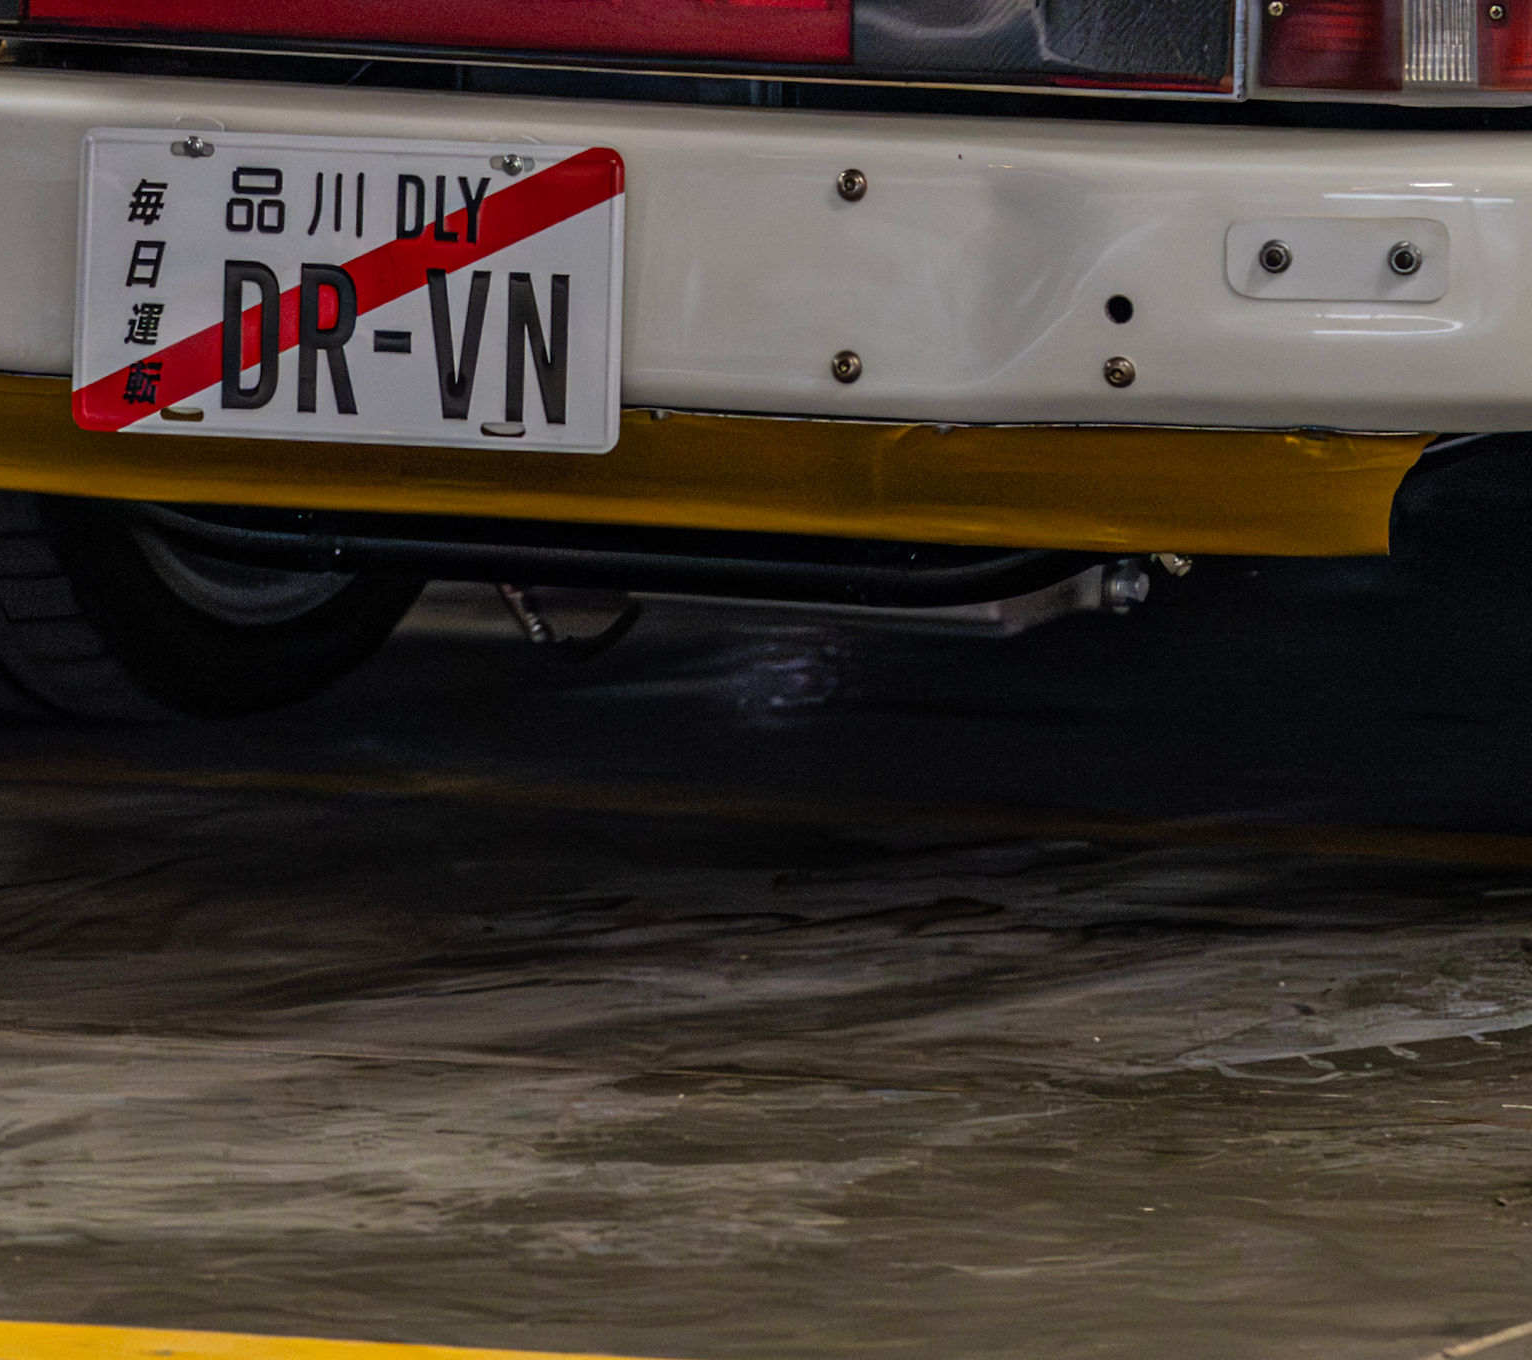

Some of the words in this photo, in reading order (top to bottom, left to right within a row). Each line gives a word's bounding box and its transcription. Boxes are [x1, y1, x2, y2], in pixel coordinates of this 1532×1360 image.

[225, 166, 367, 240] 品川
[397, 173, 491, 245] DLY
[124, 178, 168, 406] 毎日運転
[220, 259, 571, 426] DR-VN
